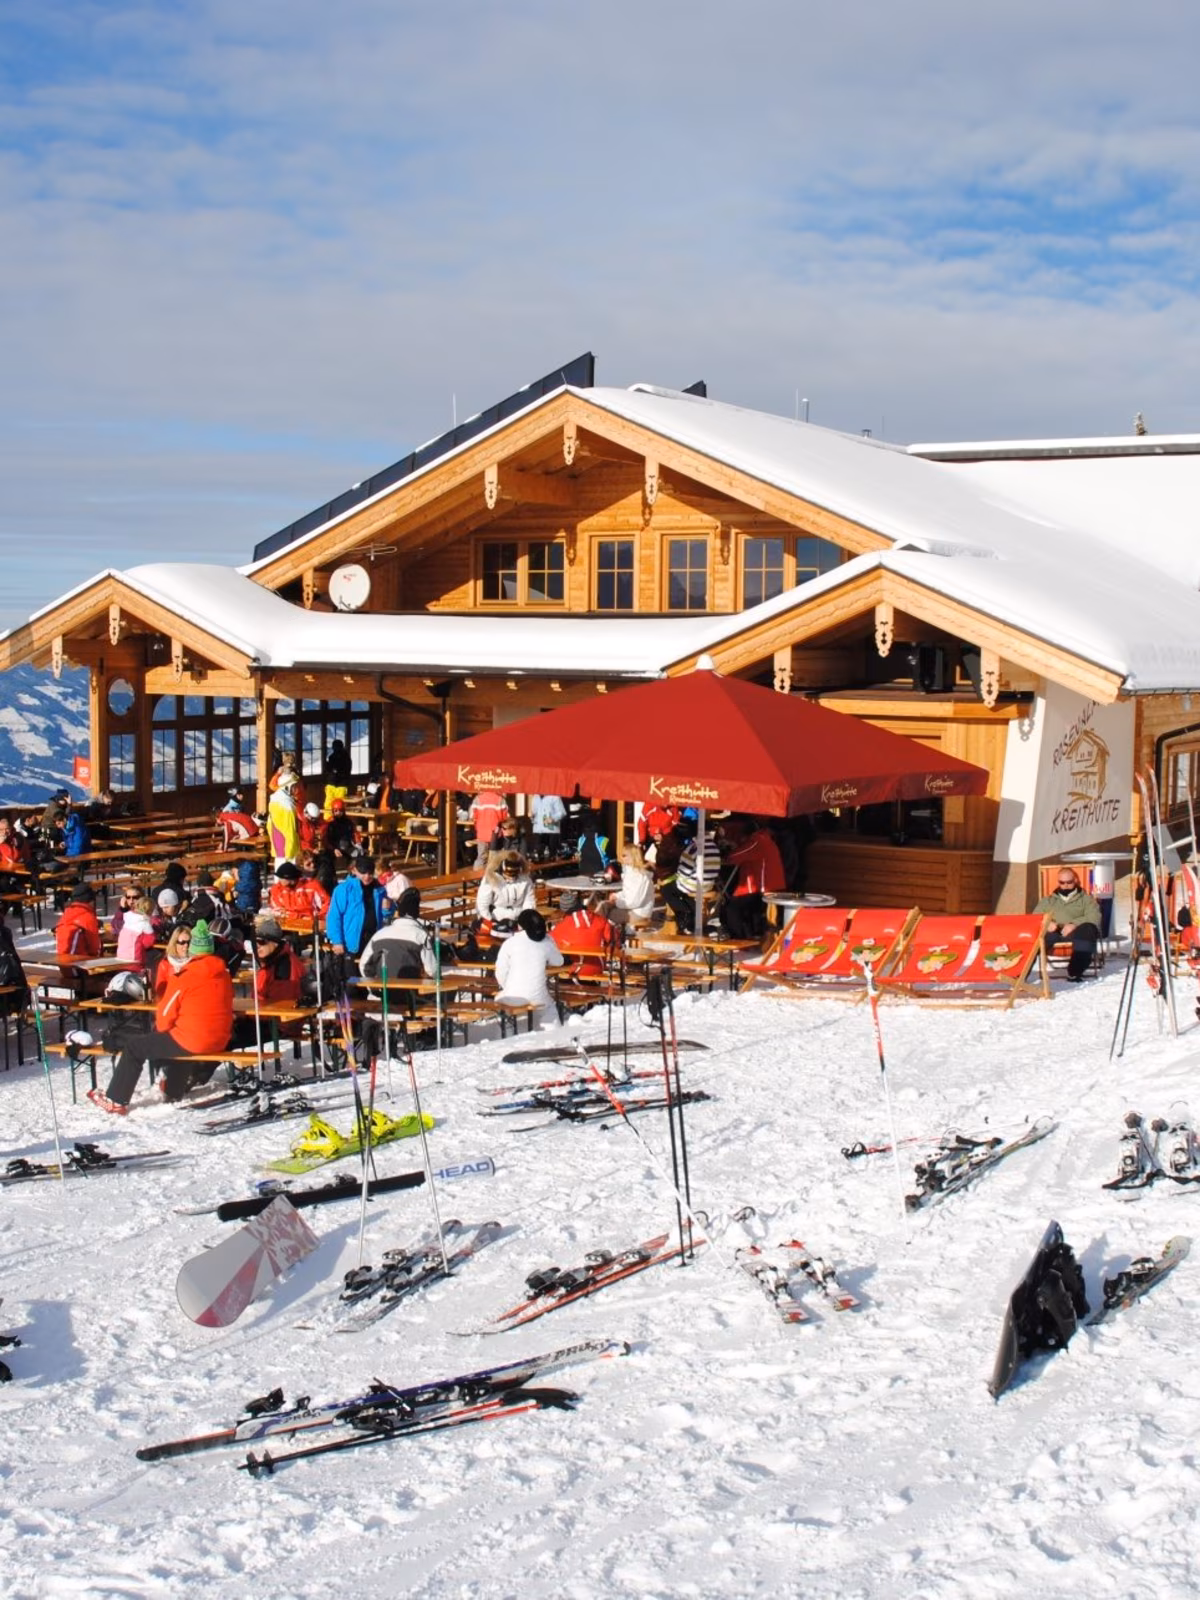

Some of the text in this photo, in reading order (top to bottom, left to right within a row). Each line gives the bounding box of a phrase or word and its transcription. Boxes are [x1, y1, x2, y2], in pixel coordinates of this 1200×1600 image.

[457, 764, 518, 786] Kreithütte
[649, 775, 719, 799] Kreithütte
[1050, 797, 1121, 835] KREITHÜTTE
